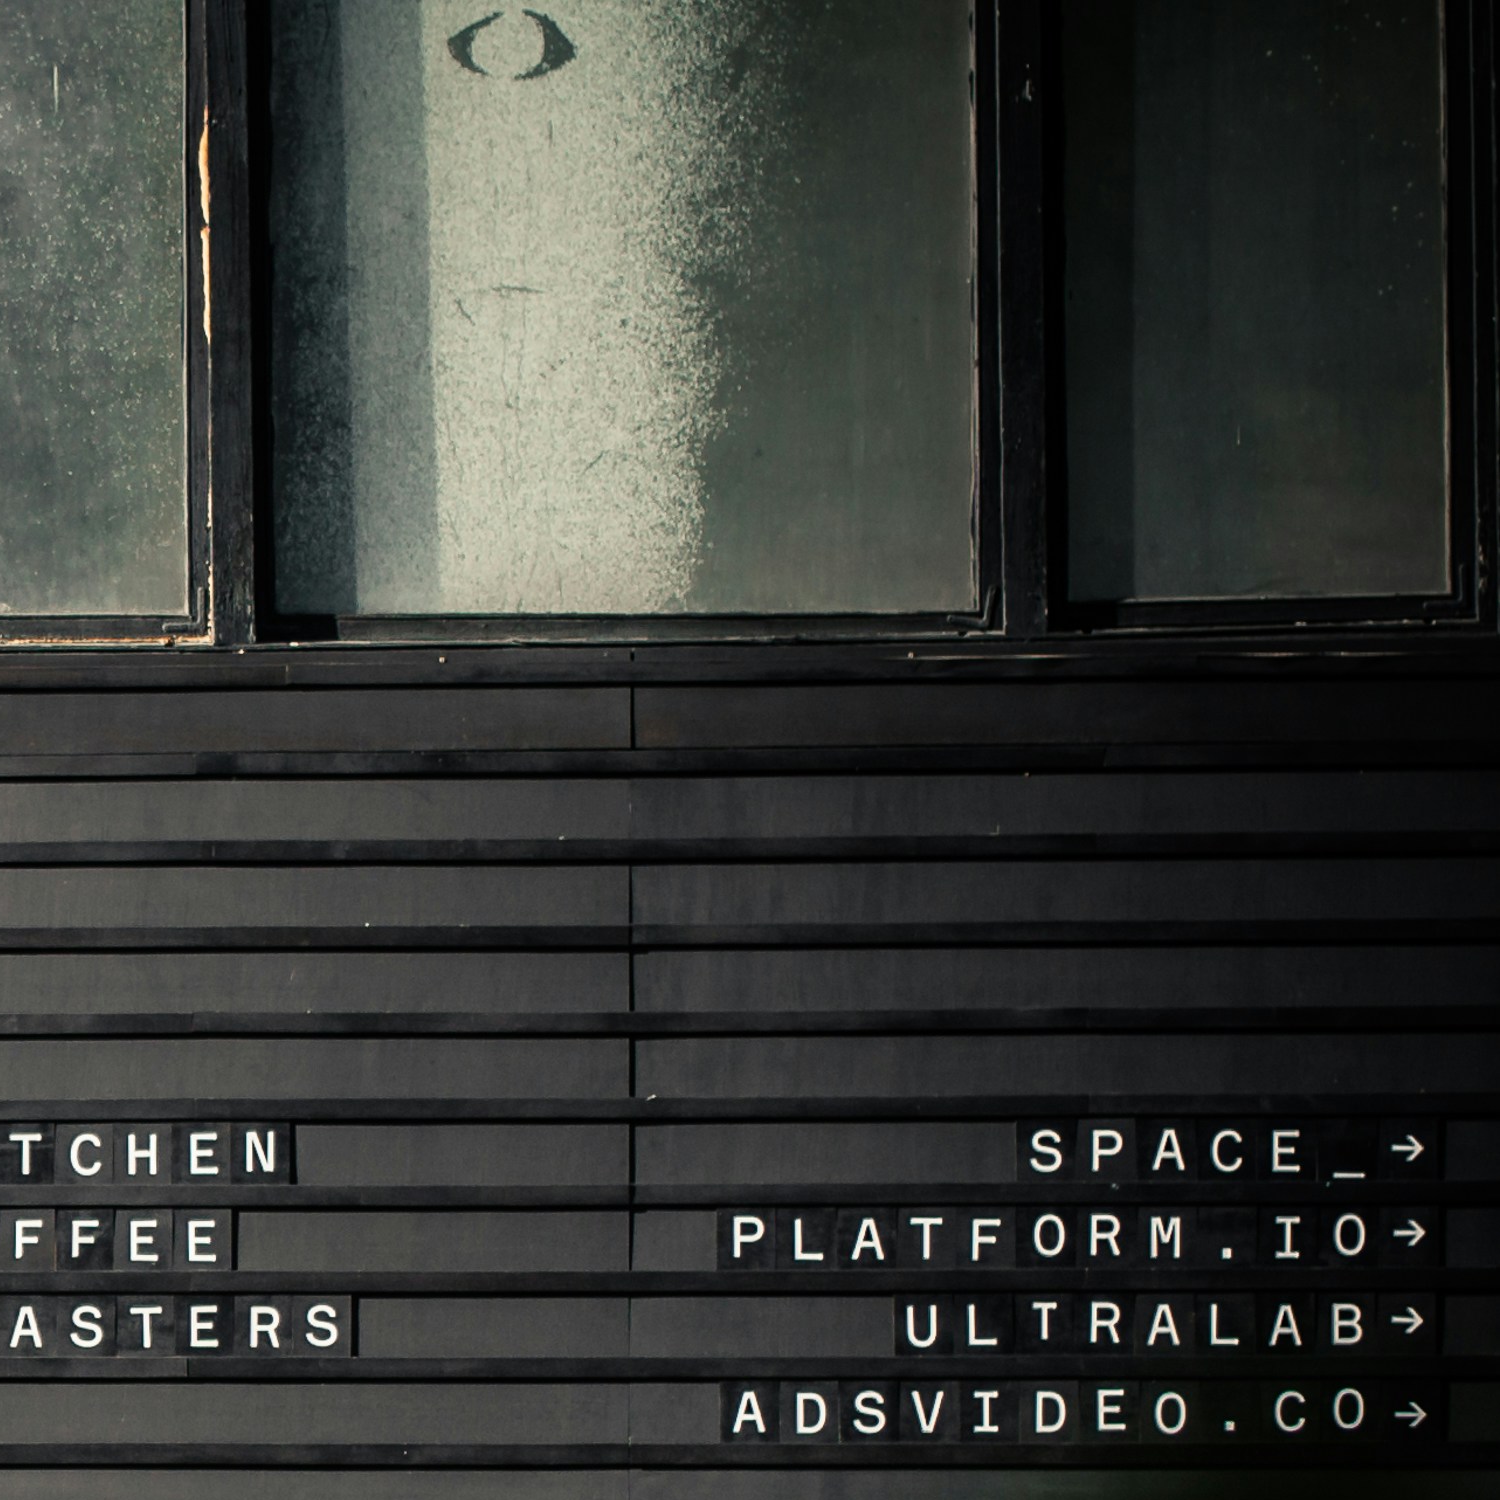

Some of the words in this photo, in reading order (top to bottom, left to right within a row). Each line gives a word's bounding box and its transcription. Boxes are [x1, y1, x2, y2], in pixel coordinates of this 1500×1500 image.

[732, 1213, 1366, 1262] PLATFORM.IO
[906, 1301, 1363, 1348] ULTRALAB
[732, 1388, 1364, 1435] ADSVIDEO.CO
